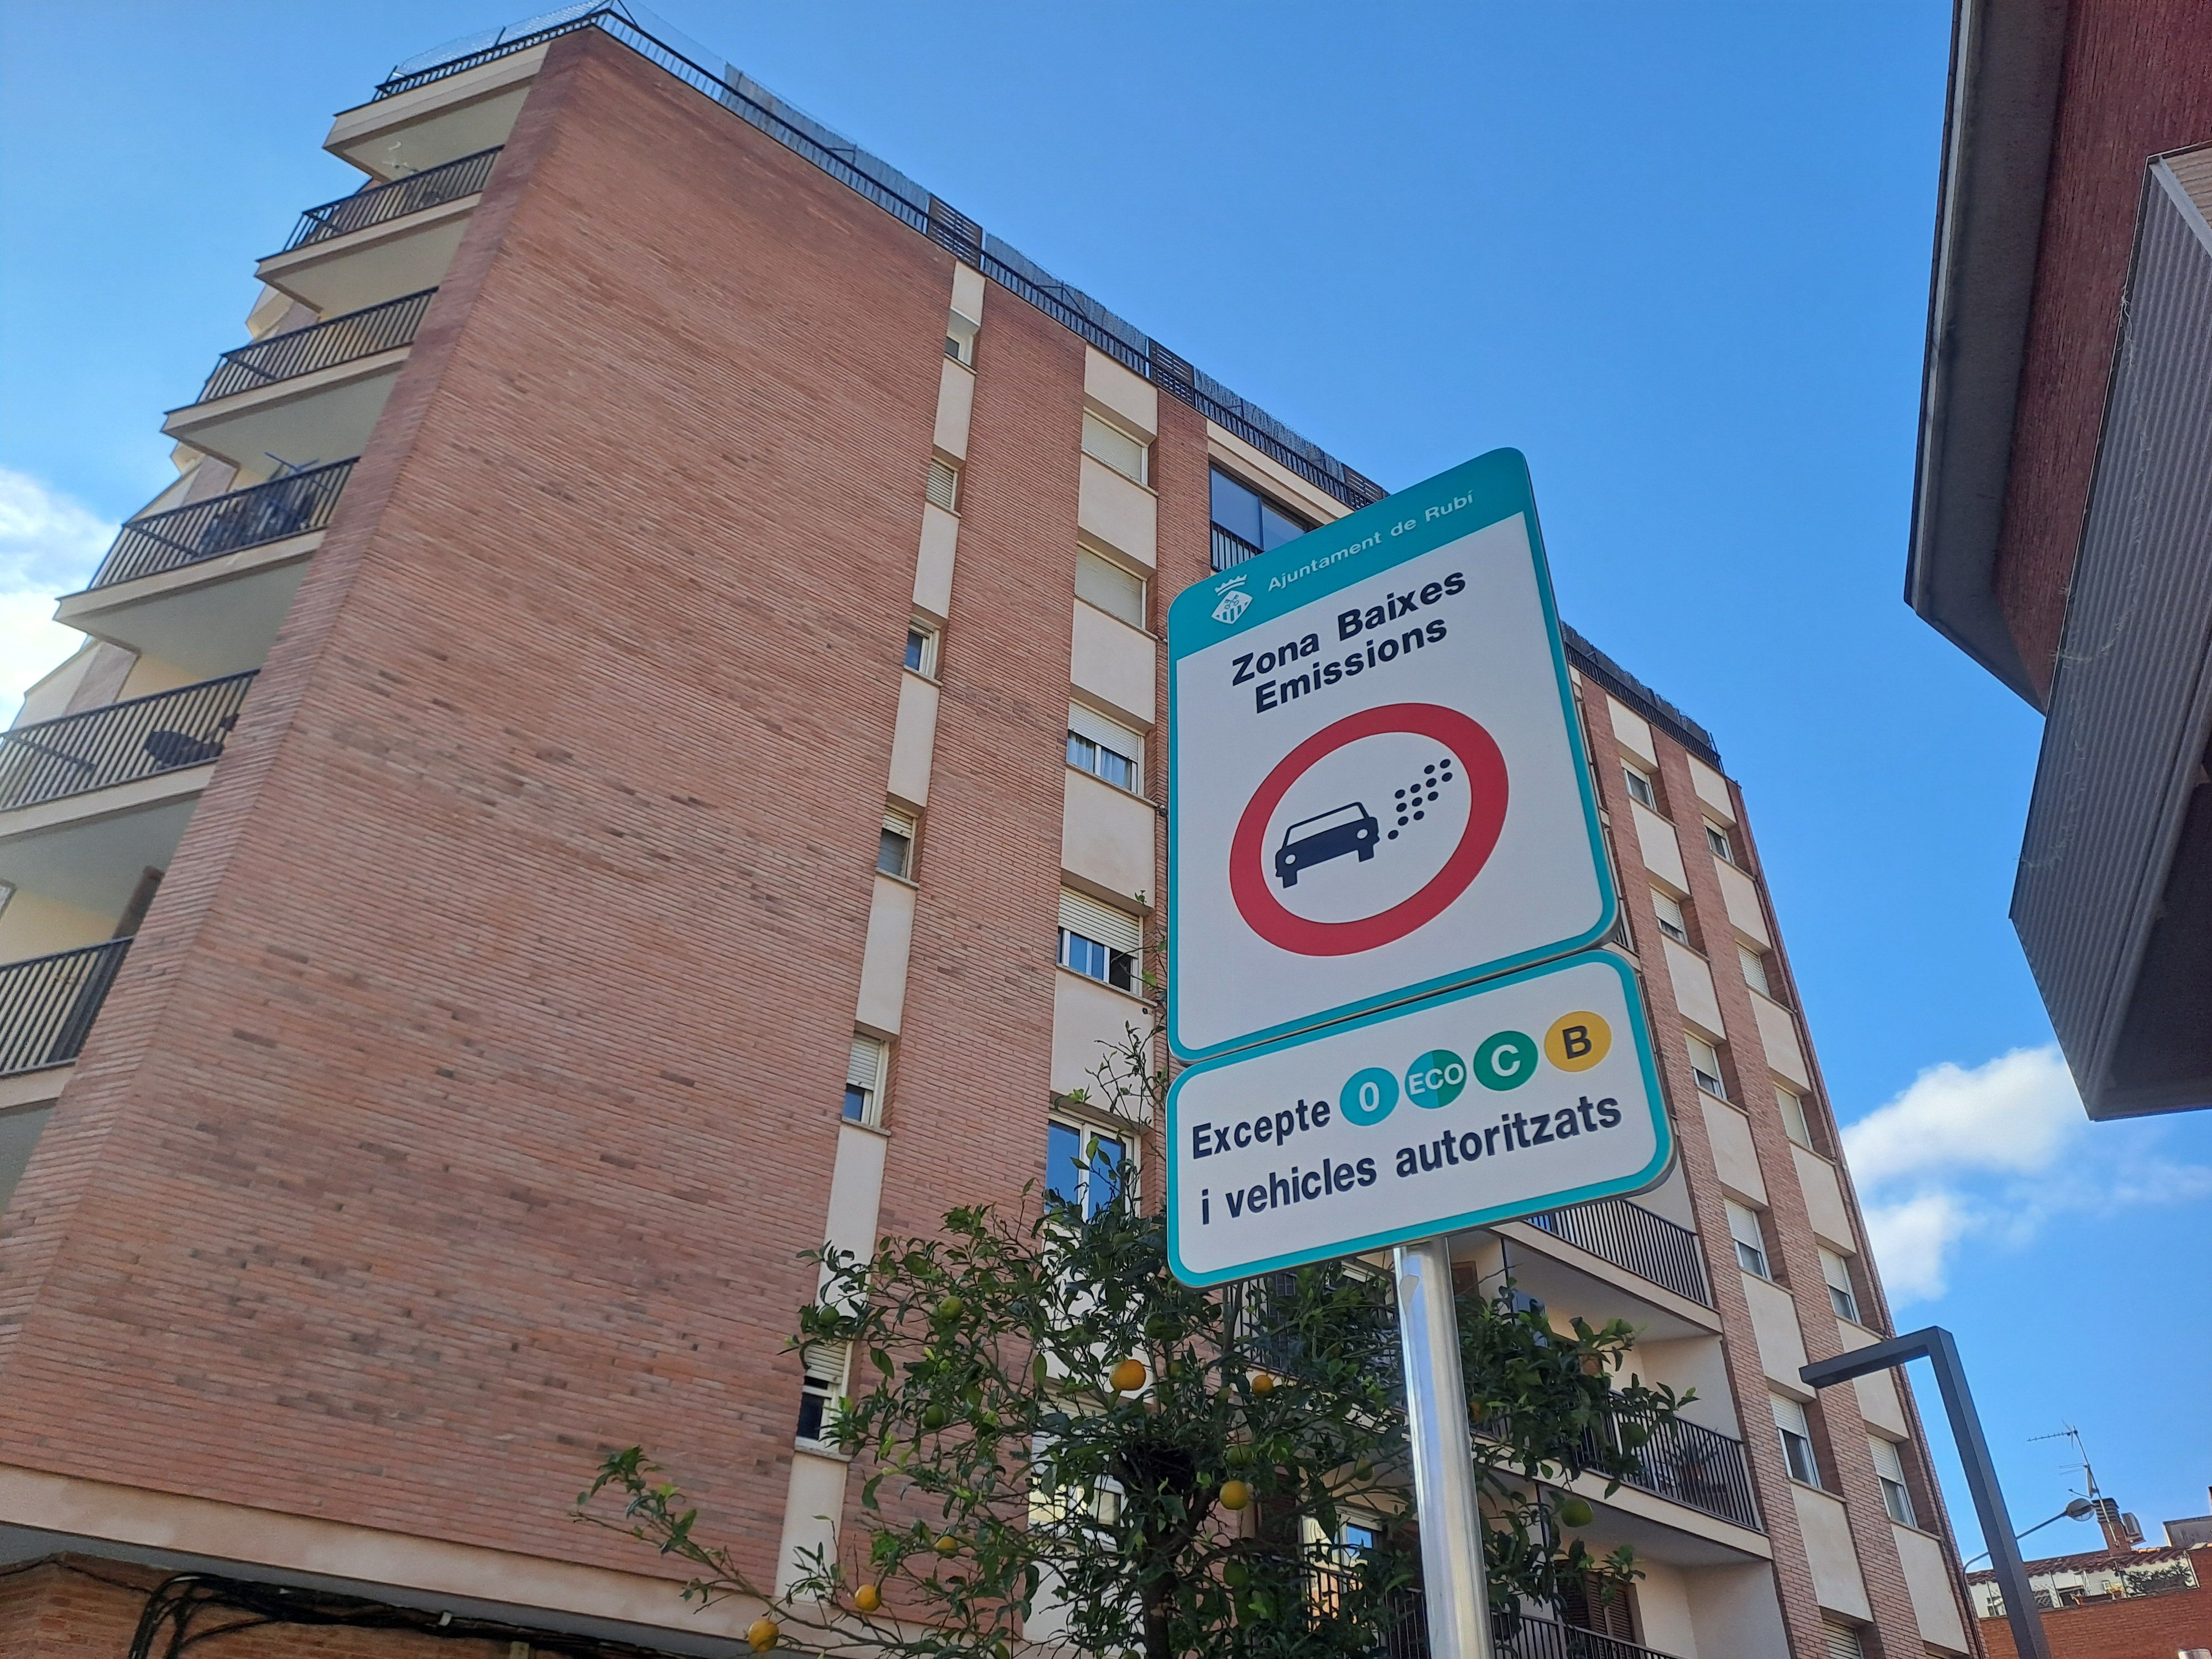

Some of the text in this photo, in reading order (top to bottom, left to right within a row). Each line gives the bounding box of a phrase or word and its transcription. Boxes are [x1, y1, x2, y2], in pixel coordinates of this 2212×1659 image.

[1267, 490, 1474, 592] Ajuntament de Rubí
[1232, 571, 1466, 686] Zona Baixes
[1255, 617, 1448, 714] Emissions
[1192, 1025, 1592, 1159] Excepte 0 ECO C B
[1202, 1095, 1622, 1225] i vehicles autoritzats
